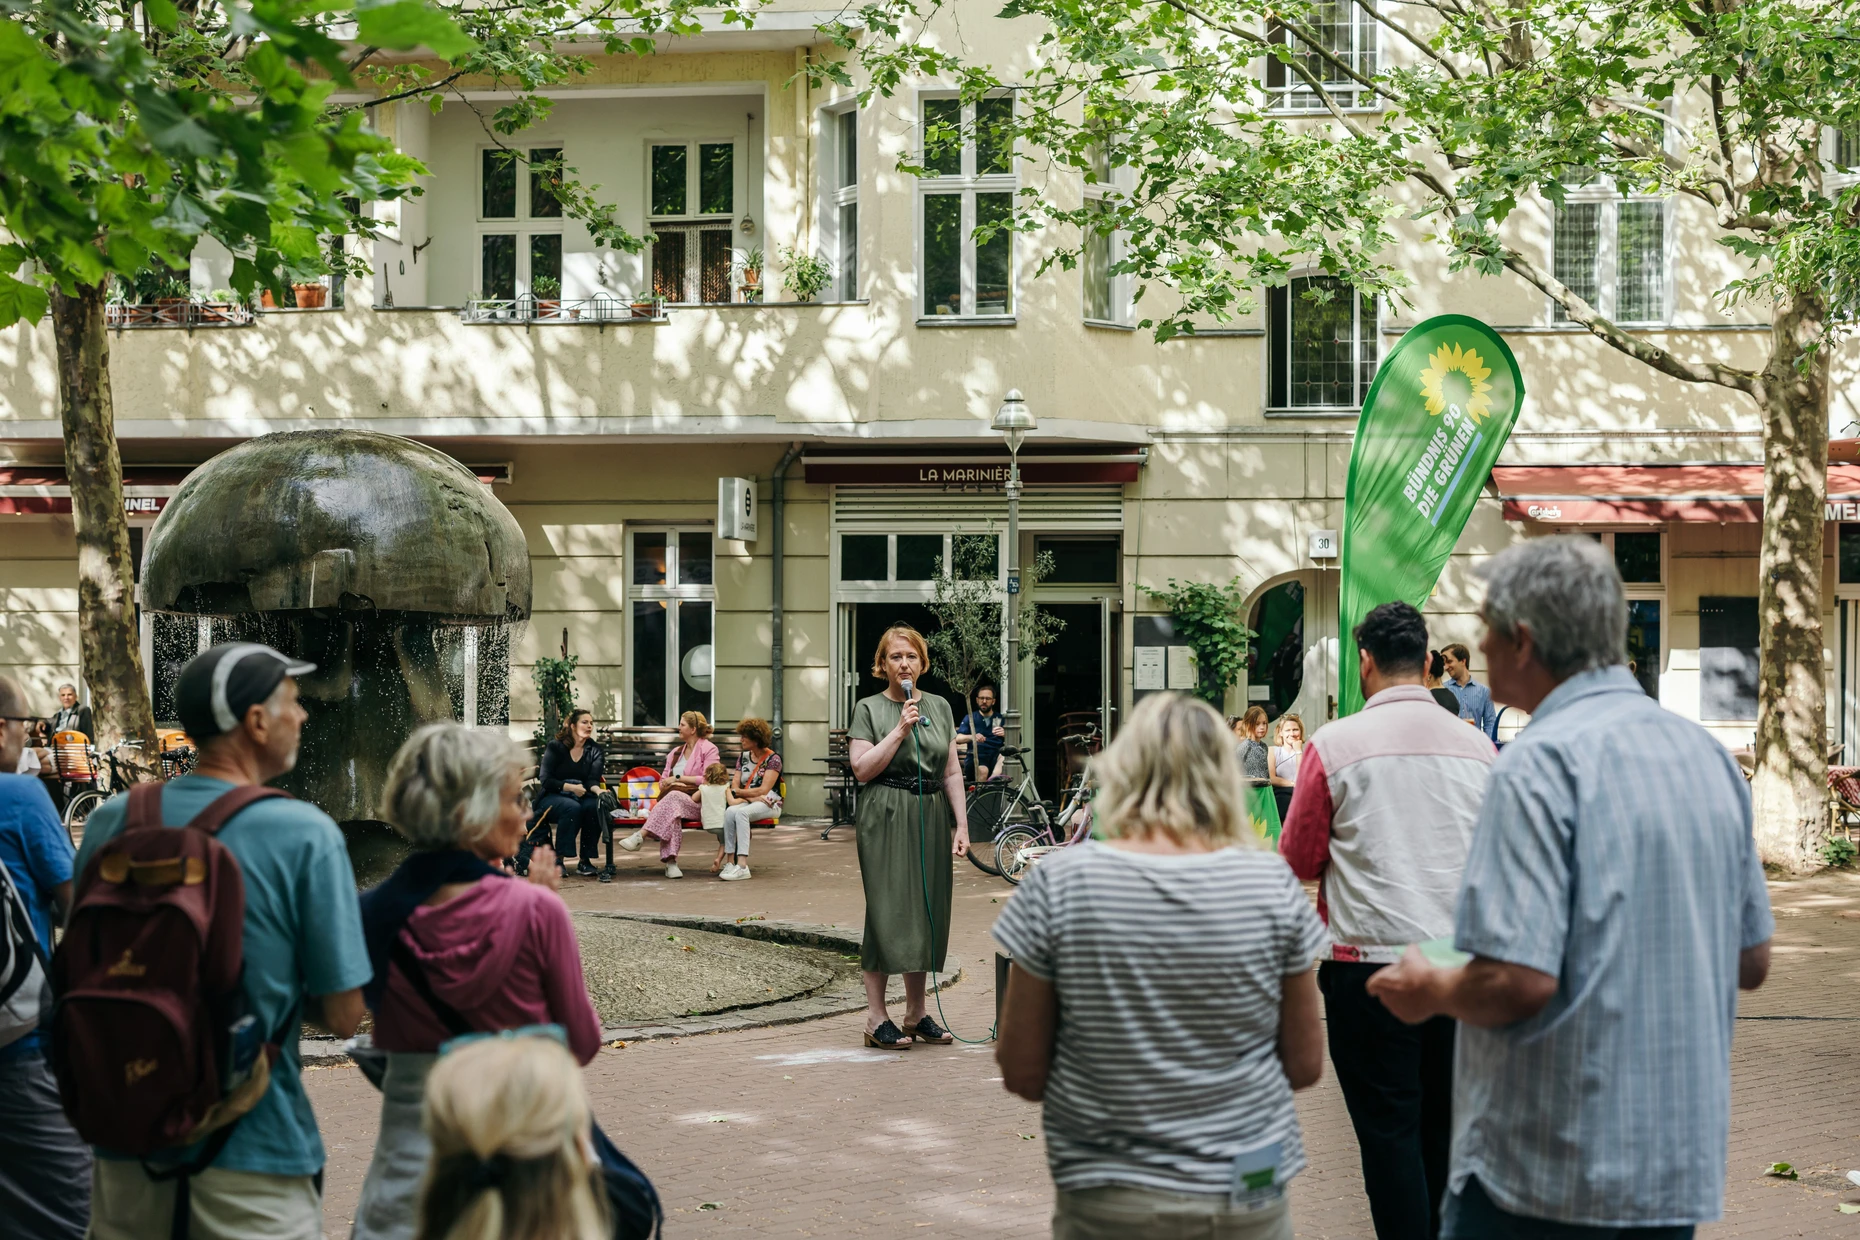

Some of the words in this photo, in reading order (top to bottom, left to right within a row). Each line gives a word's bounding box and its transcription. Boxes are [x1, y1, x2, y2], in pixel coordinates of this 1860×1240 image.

[1403, 427, 1448, 503] BÜNDNIS
[1443, 403, 1461, 430] 90
[920, 469, 939, 481] LA
[1417, 484, 1440, 519] DIE
[1434, 416, 1476, 486] GRÜNEN
[1824, 503, 1860, 520] ME
[1318, 538, 1330, 549] 30
